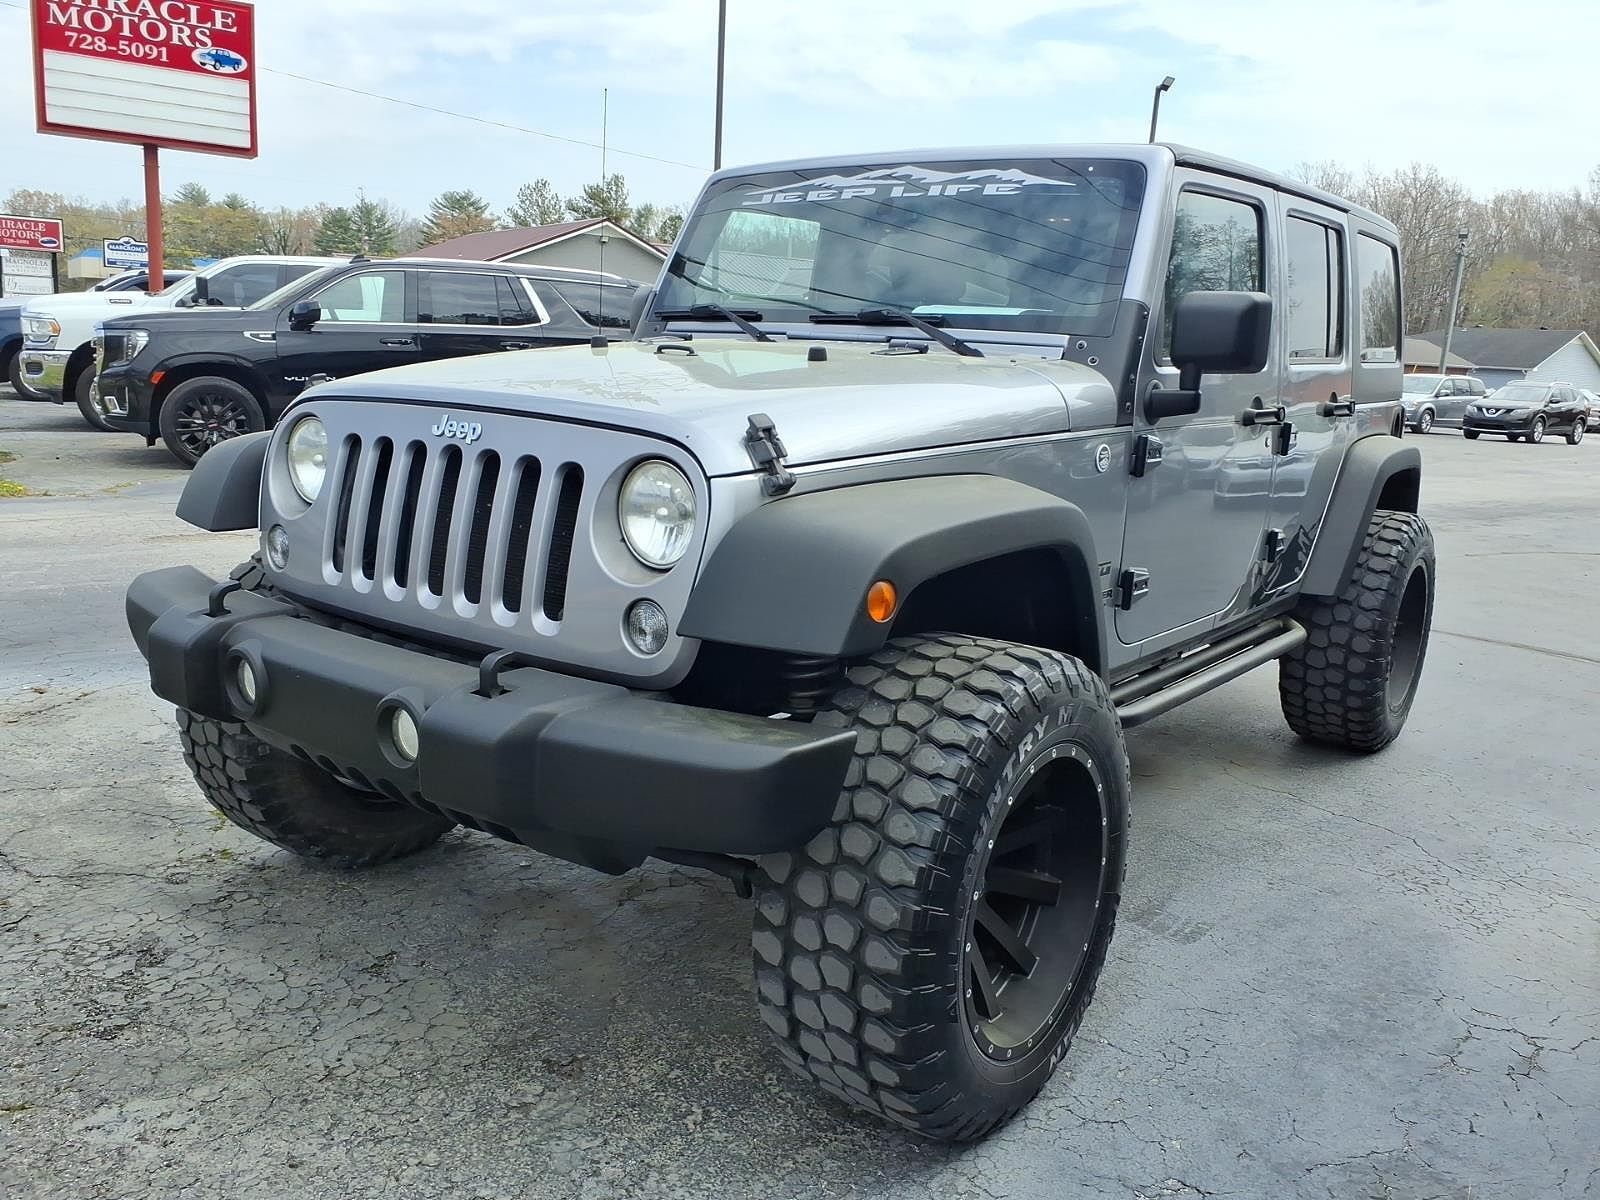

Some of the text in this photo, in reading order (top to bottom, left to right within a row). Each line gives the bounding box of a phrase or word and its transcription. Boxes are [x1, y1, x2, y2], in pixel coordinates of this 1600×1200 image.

[46, 2, 213, 49] MOTORS
[53, 0, 238, 33] RACLE
[64, 31, 169, 62] 728-5091
[742, 183, 1024, 206] JEEP LIFE
[0, 219, 46, 232] IRACLE
[0, 228, 42, 240] OTORS
[431, 414, 482, 445] Jeep
